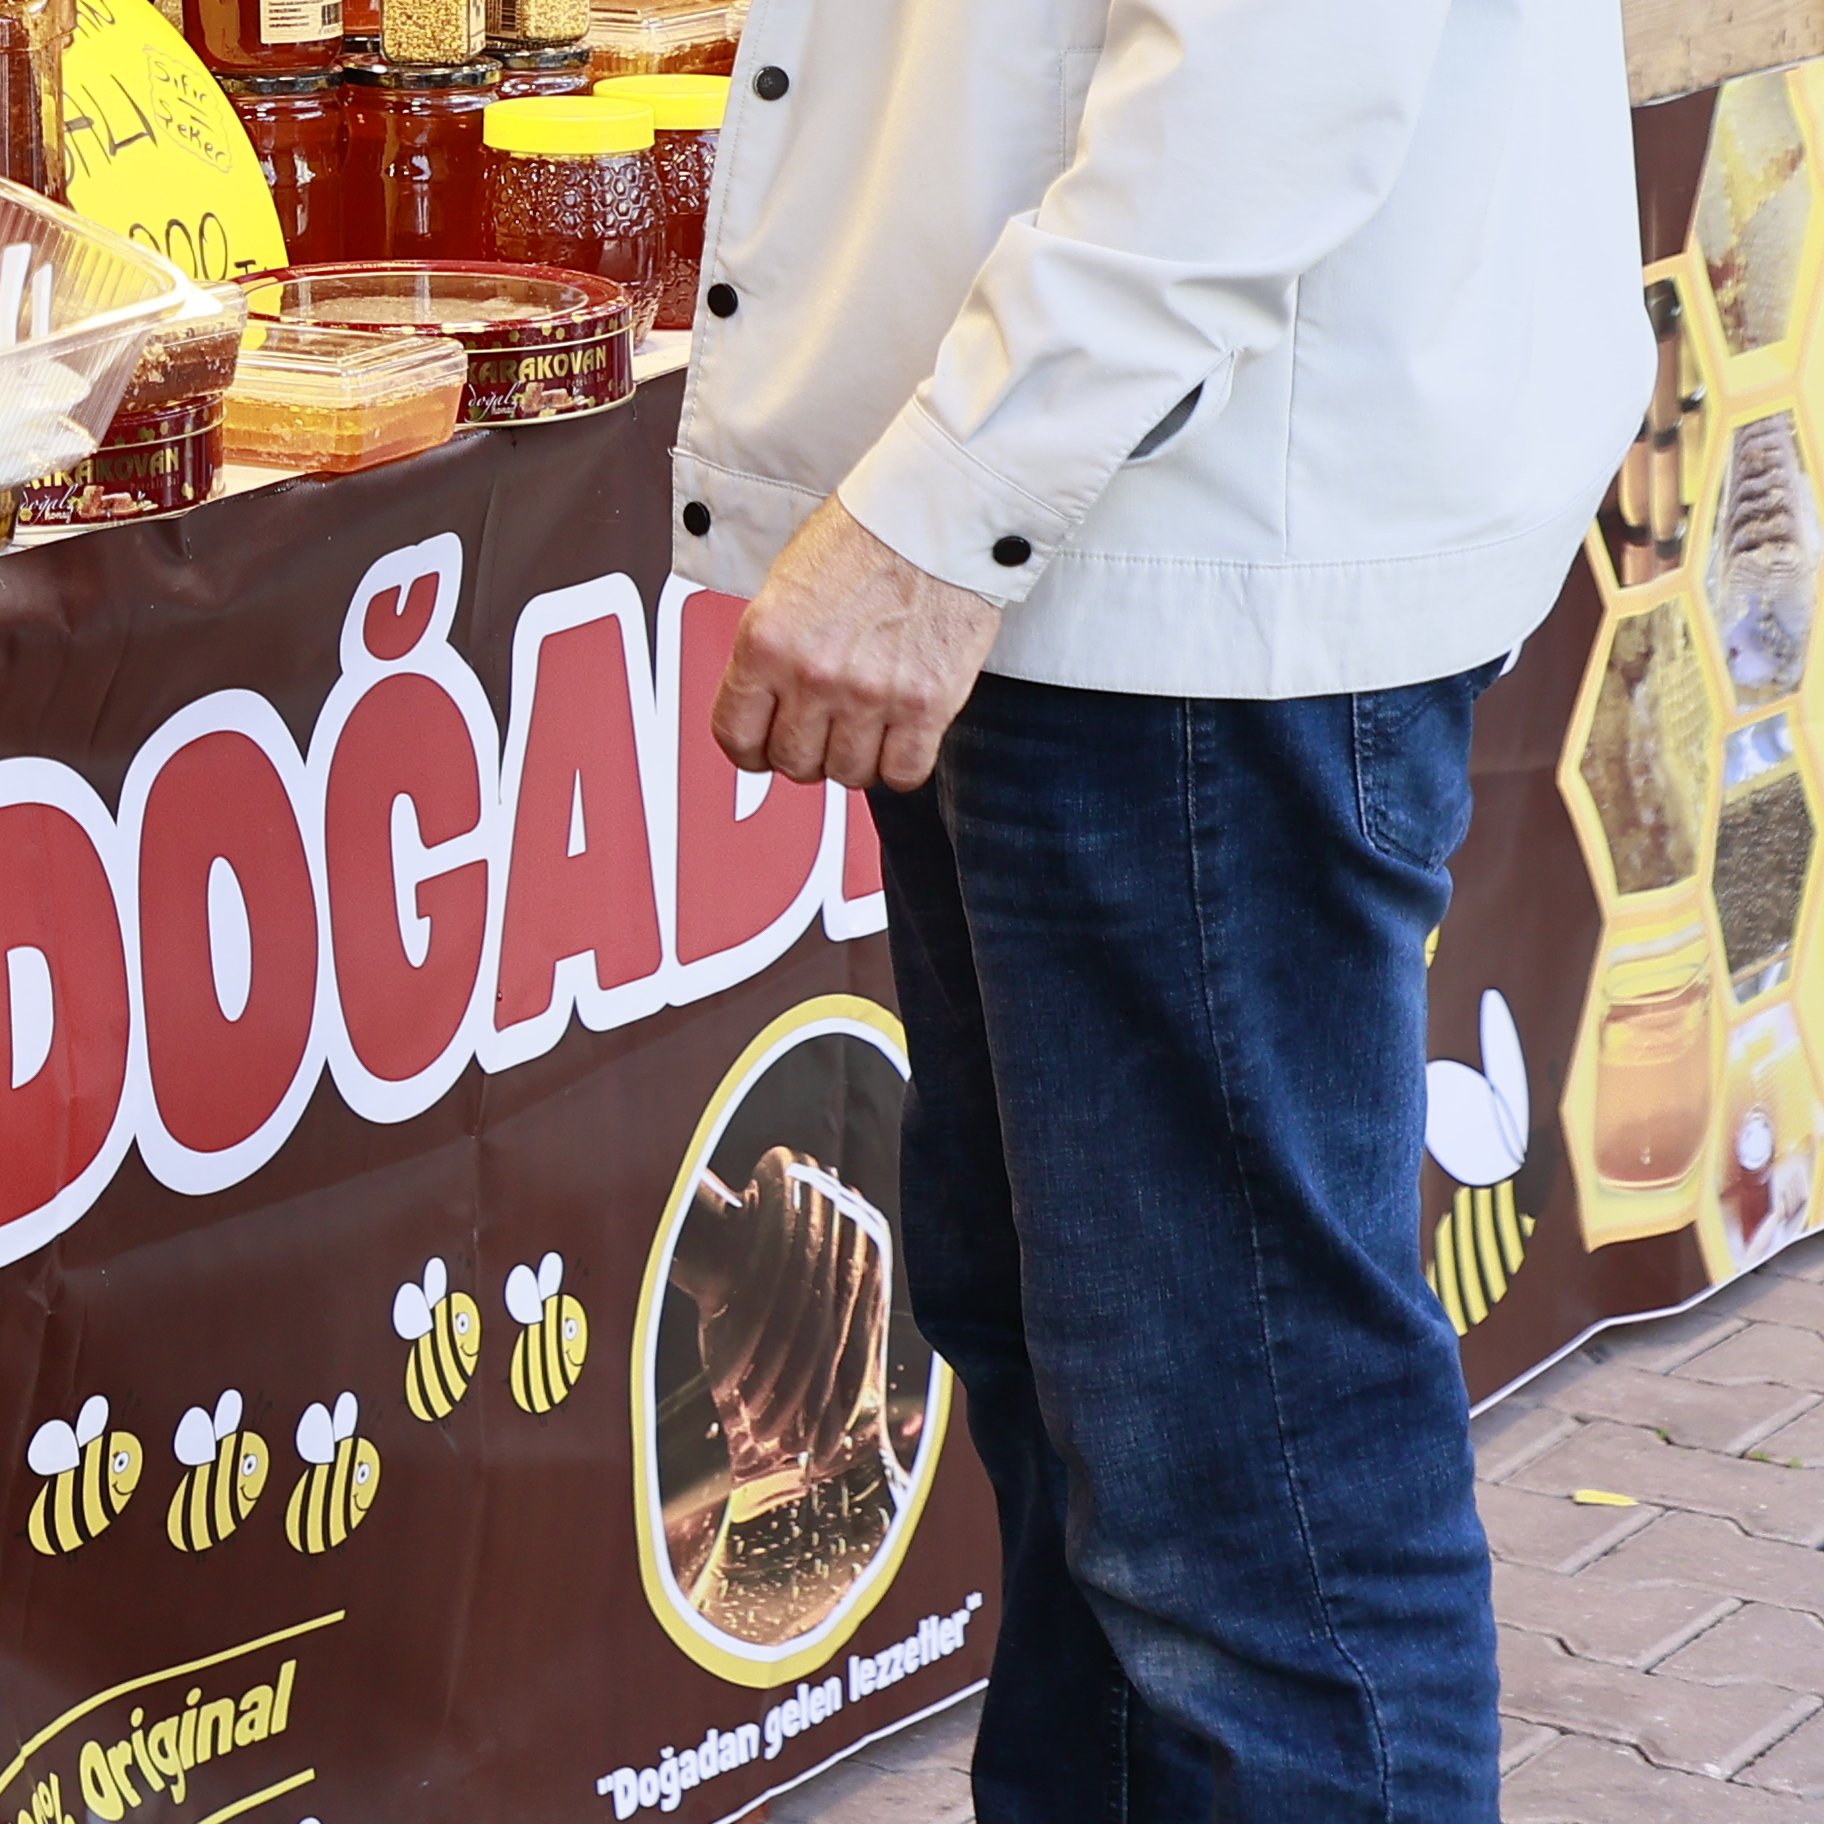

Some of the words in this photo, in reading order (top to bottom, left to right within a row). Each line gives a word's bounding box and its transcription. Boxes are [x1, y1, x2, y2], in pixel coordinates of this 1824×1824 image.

[468, 344, 607, 385] KARAKOVAN
[79, 1659, 297, 1823] Original
[596, 1722, 761, 1822] "Doğadan
[763, 1674, 844, 1762] gelen
